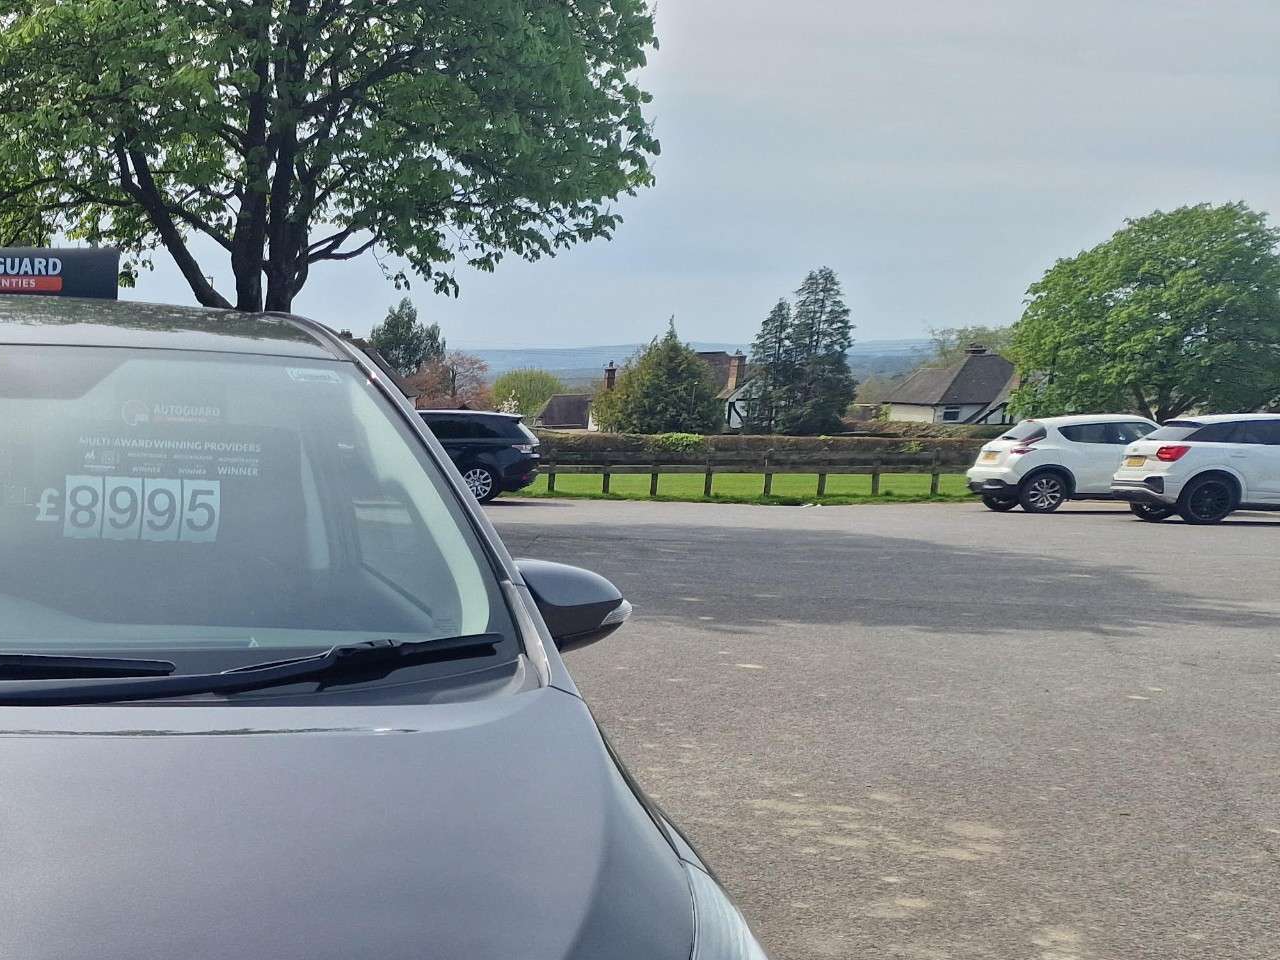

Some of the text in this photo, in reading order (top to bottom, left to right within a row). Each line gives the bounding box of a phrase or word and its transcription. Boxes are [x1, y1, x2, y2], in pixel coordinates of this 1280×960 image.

[113, 438, 152, 449] AWARD
[154, 439, 202, 451] WINNING
[204, 441, 261, 453] PROVIDERS
[218, 465, 259, 476] WINNER
